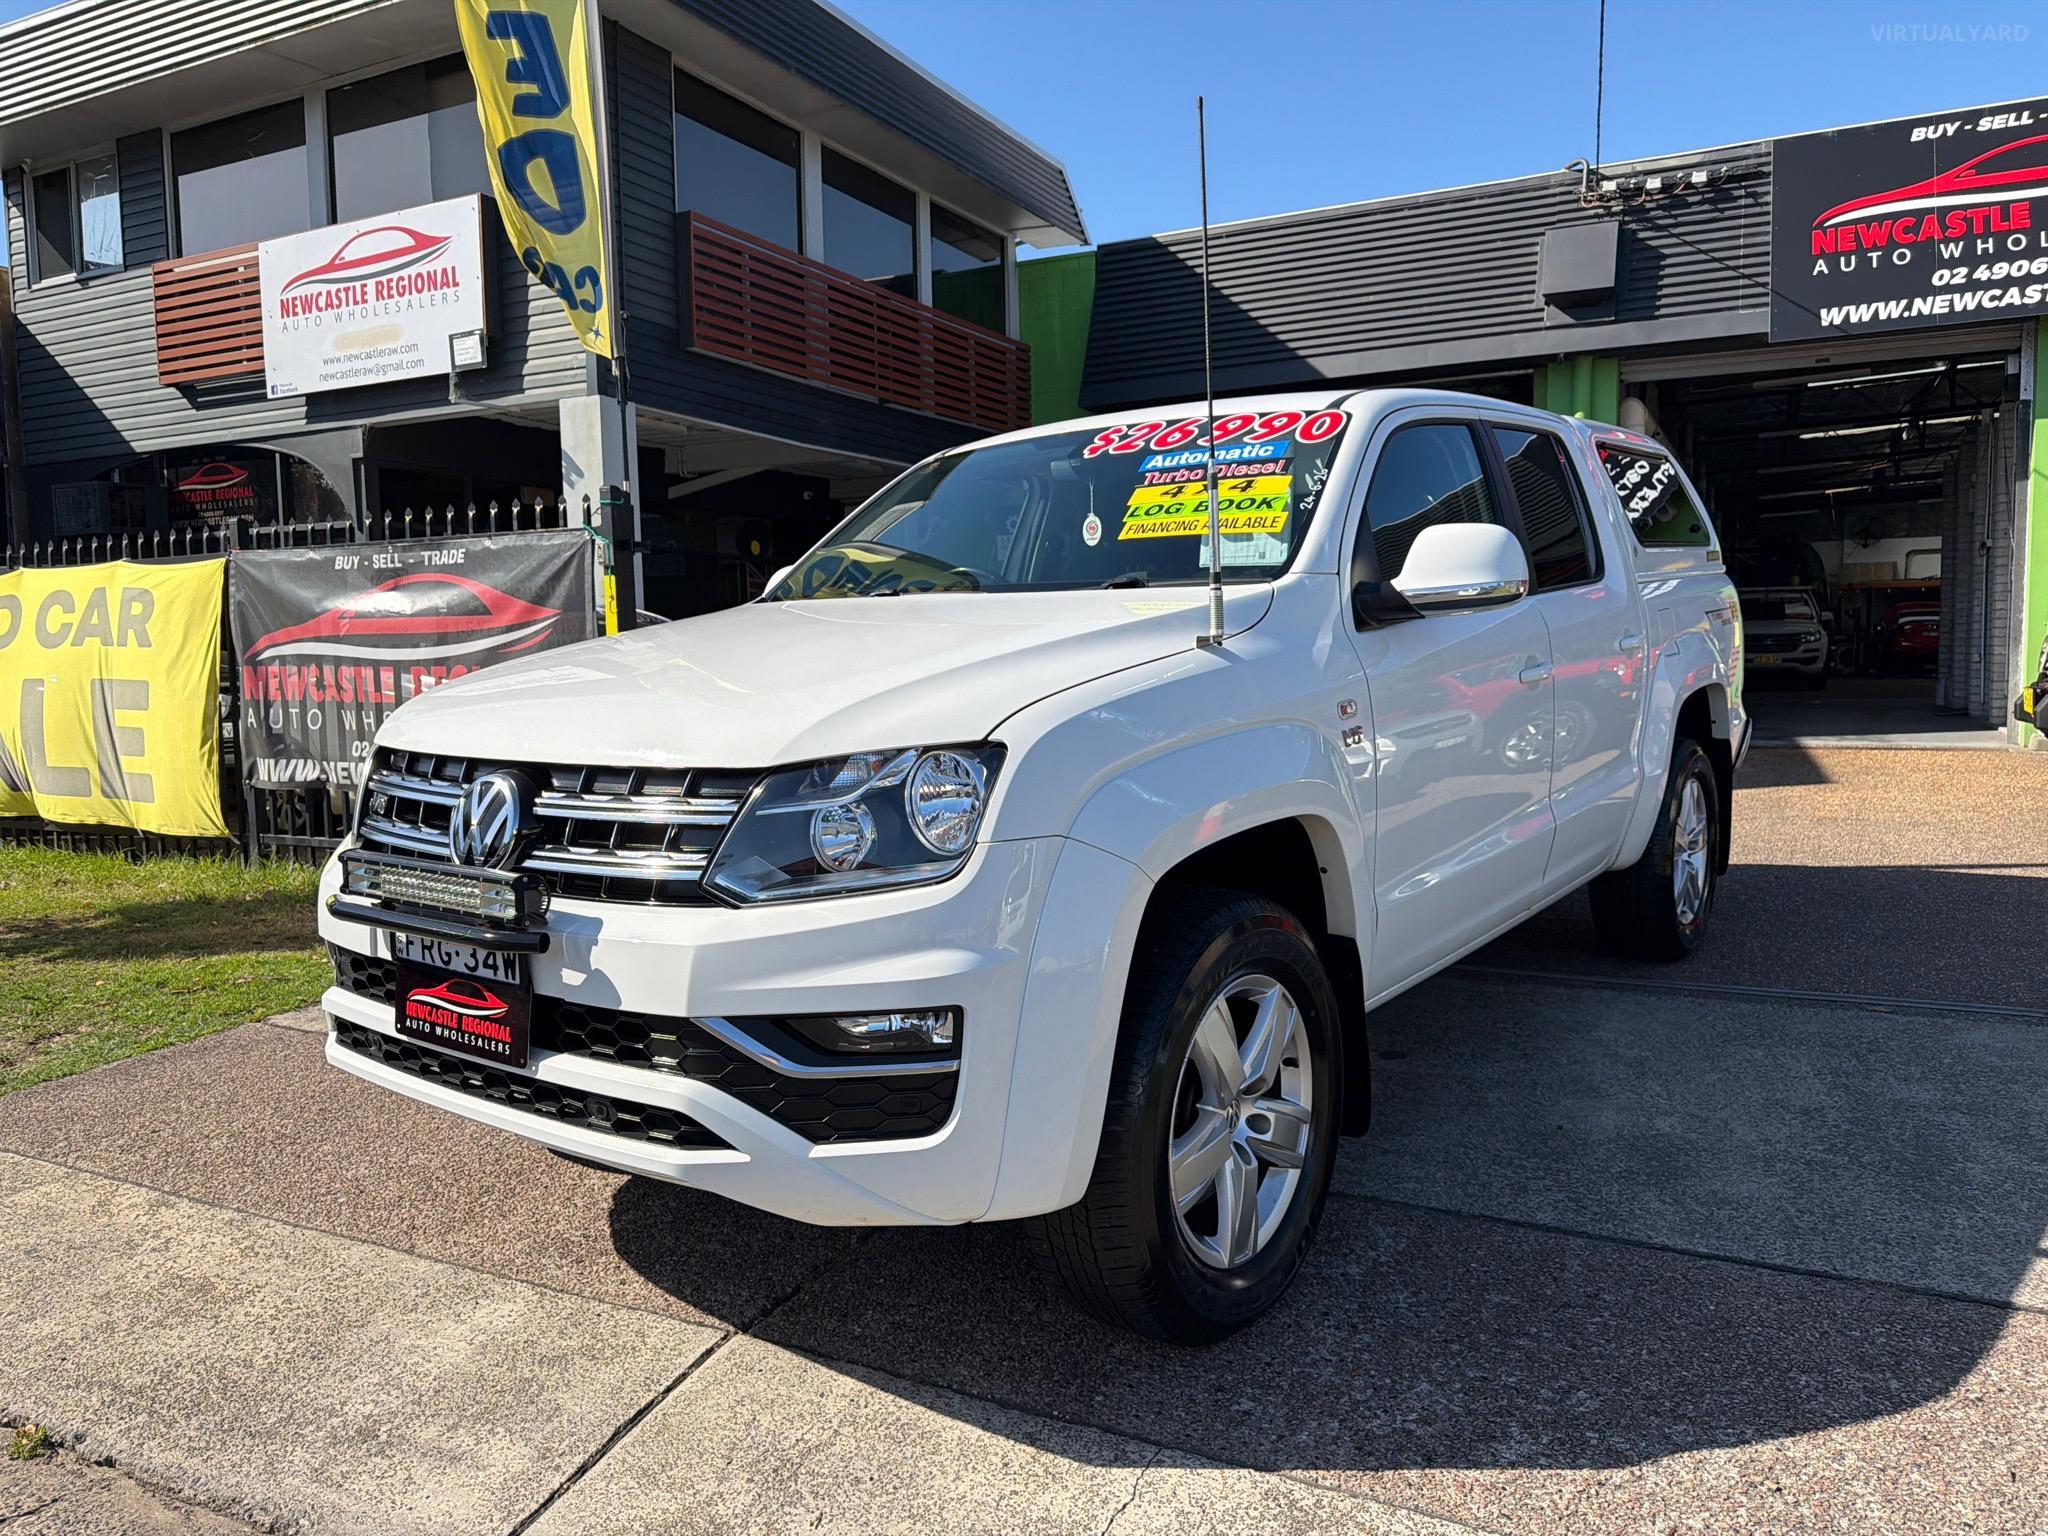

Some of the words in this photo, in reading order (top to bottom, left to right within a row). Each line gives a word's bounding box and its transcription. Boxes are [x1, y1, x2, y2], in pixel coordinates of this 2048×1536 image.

[1910, 121, 1962, 142] BUY
[1976, 110, 2034, 131] SELL
[1811, 201, 2031, 256] NEWCASTLE
[1812, 248, 1911, 276] AUTO
[1931, 267, 1969, 286] 02
[1972, 257, 2048, 281] 4906
[280, 283, 369, 319] NEWCASTLE
[375, 266, 460, 302] REGIONAL
[282, 315, 322, 333] AUTO
[333, 290, 460, 323] WHOLESALERS
[322, 343, 419, 366] www.newcastleraw.com
[319, 357, 425, 383] newcastleraw@gmail.com
[1083, 409, 1347, 460] $26990
[1146, 444, 1274, 469] Automatic
[1144, 468, 1205, 485] Turbo
[1160, 485, 1188, 498] 4
[1228, 479, 1260, 493] 4
[1127, 502, 1185, 518] LOG
[1192, 496, 1282, 514] BOOK
[1126, 519, 1200, 535] FINANCING
[335, 556, 360, 570] BUY
[372, 553, 402, 568] SELL
[421, 549, 466, 566] TRADE
[35, 586, 155, 649] CAR
[243, 664, 395, 703] NEWCASTLE
[248, 708, 322, 730] AUTO
[406, 1001, 458, 1030] NEWCASTLE
[462, 1016, 512, 1042] REGIONAL
[406, 1018, 431, 1033] AUTO
[435, 1025, 510, 1055] WHOLESALERS
